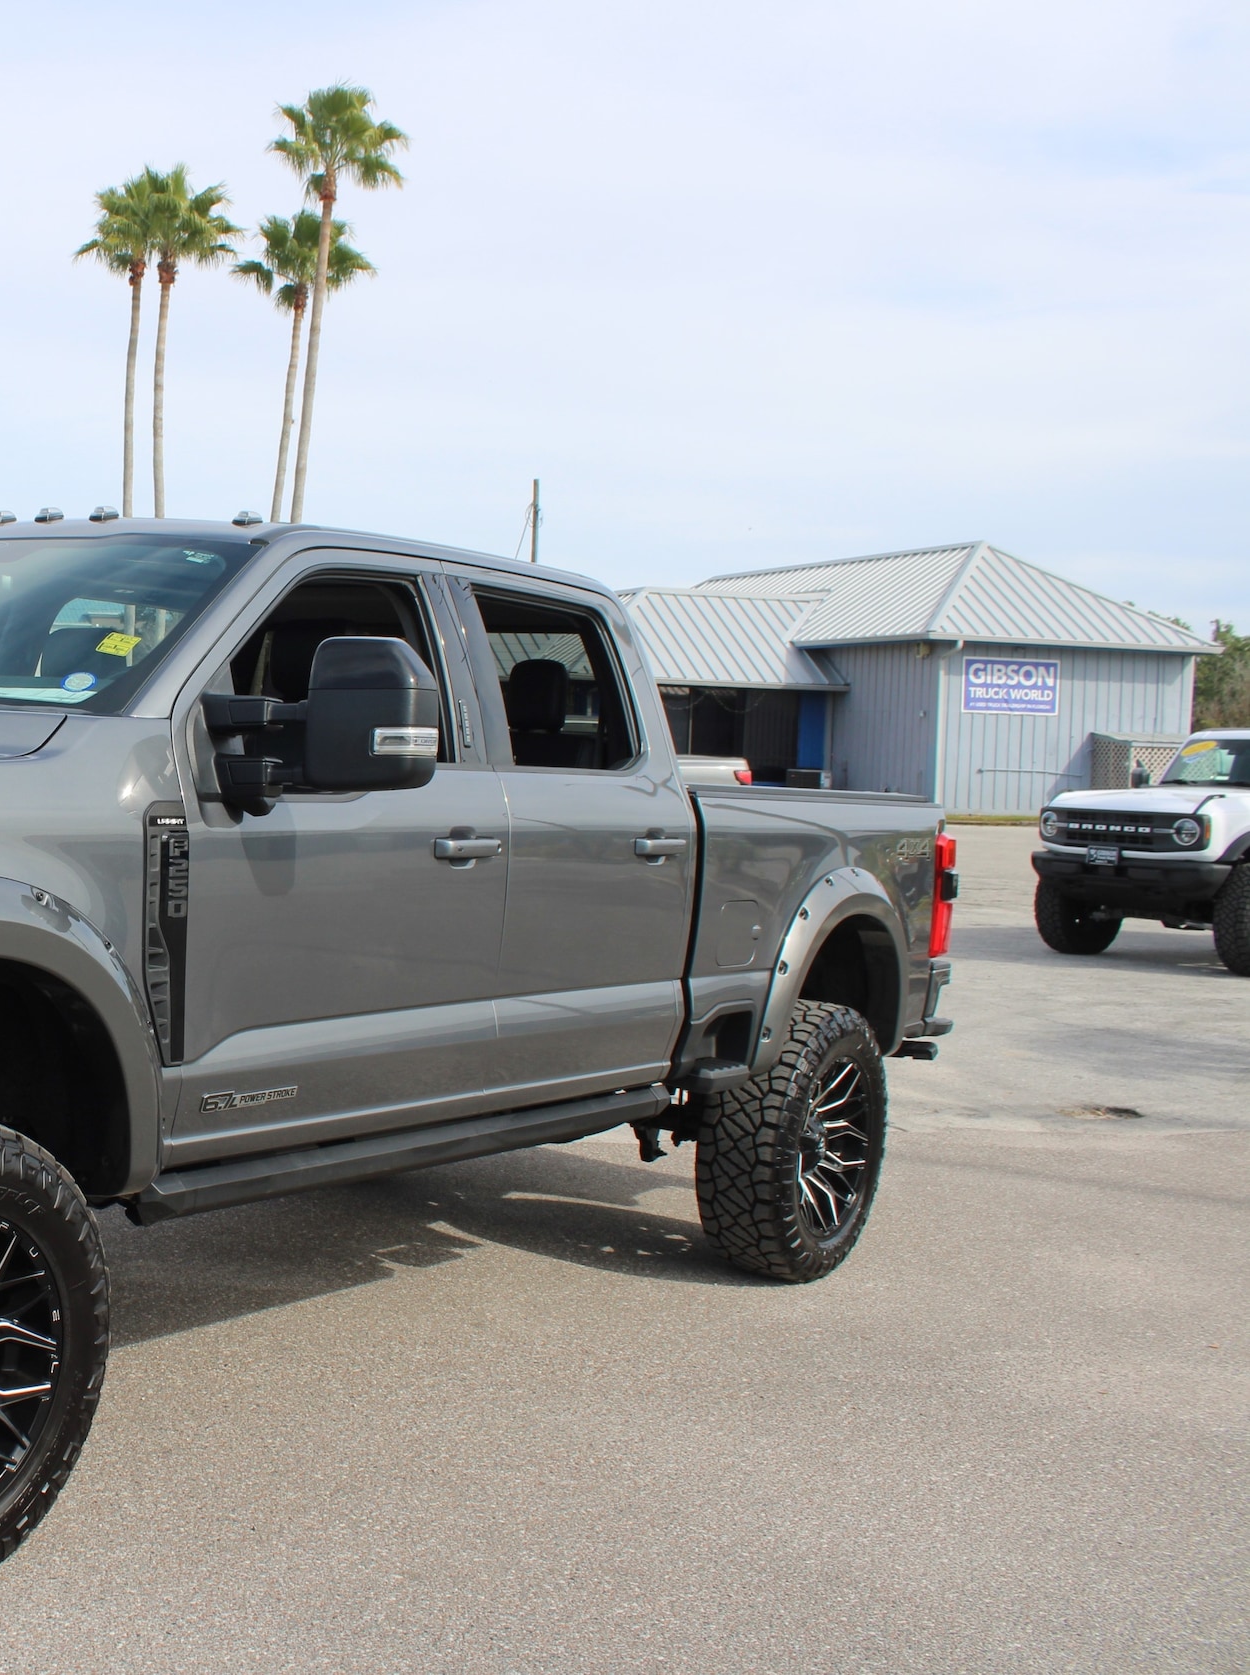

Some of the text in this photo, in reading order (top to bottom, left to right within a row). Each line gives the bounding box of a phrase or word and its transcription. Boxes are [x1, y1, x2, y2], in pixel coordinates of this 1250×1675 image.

[968, 663, 1055, 686] GIBSON
[969, 686, 1053, 701] TRUCK WORLD
[1068, 822, 1151, 833] BRONCO
[239, 1093, 266, 1104] POWER
[266, 1088, 296, 1100] STROKE
